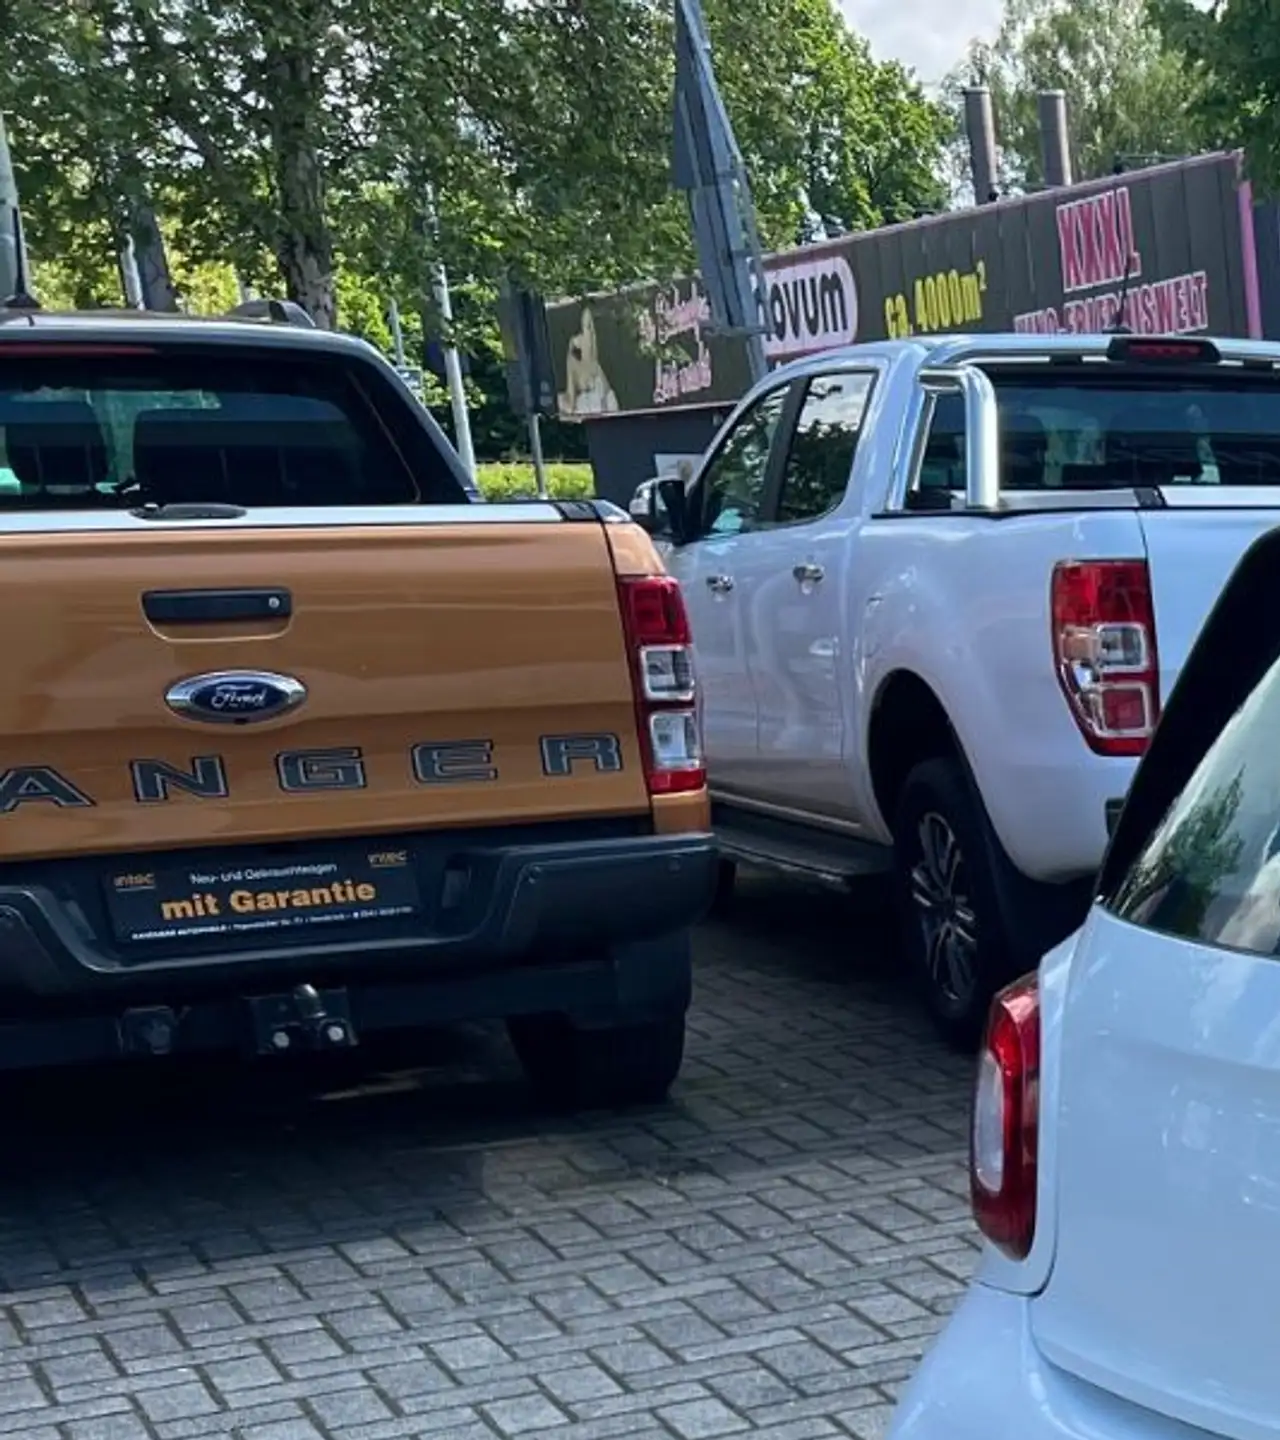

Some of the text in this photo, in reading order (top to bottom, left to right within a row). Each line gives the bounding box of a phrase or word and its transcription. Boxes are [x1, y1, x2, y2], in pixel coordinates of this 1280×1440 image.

[1056, 186, 1141, 293] XXXL
[210, 683, 268, 709] Ford
[161, 893, 221, 921] mit
[229, 879, 377, 914] Garantie
